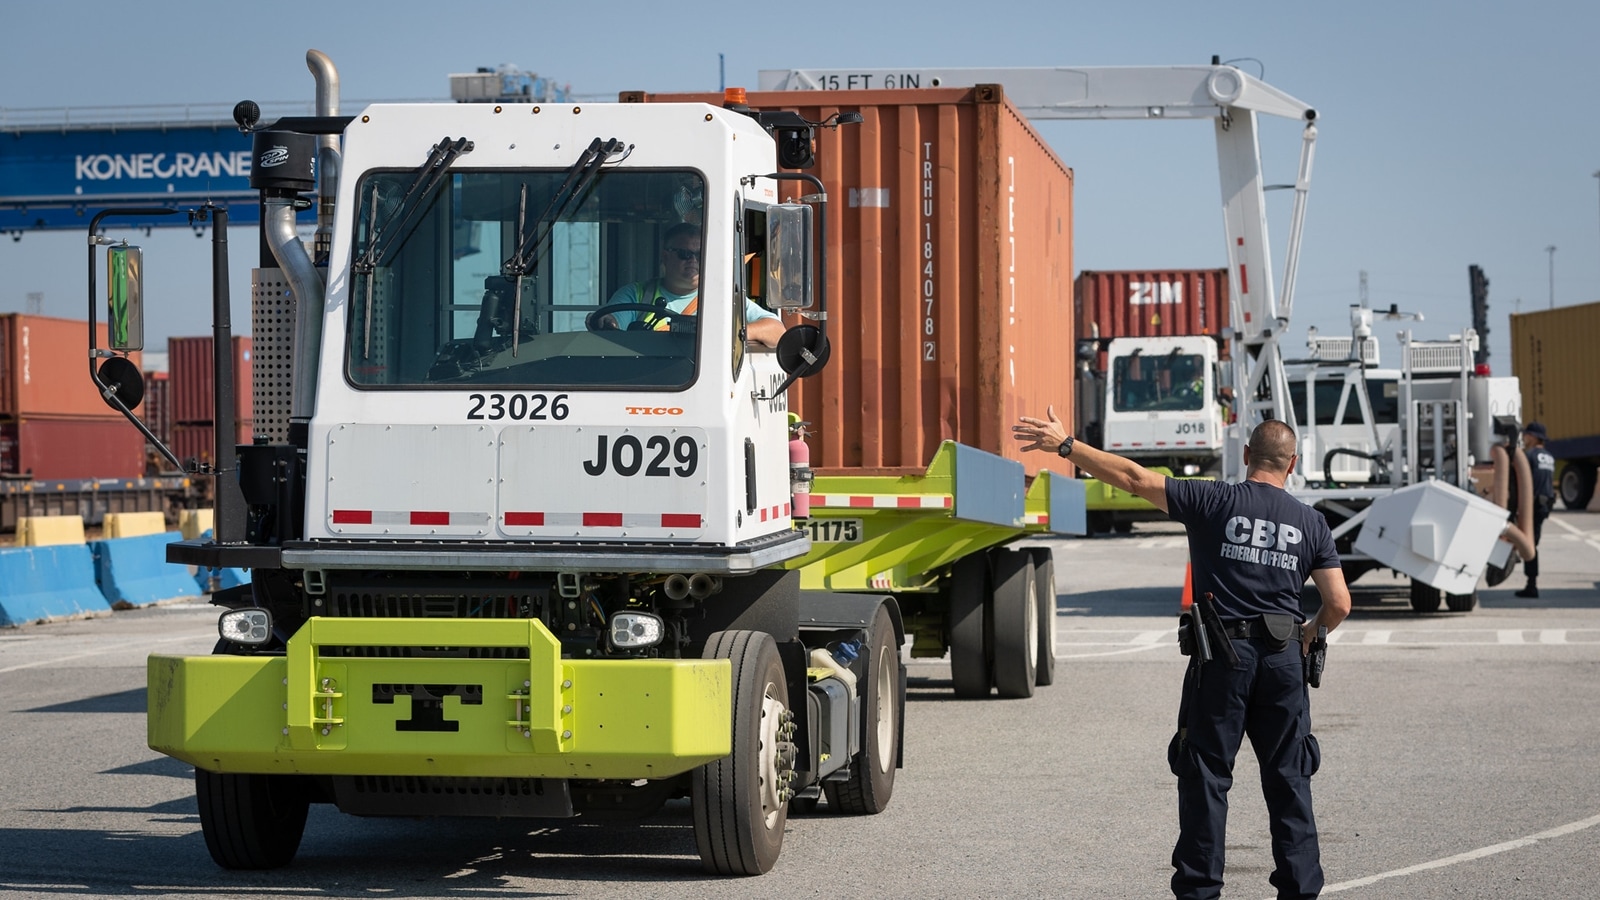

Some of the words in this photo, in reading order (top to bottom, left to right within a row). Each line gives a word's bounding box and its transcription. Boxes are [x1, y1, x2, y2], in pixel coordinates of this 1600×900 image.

[818, 75, 840, 91] 15
[847, 74, 873, 90] FT
[261, 152, 279, 161] TOP
[269, 154, 289, 163] SPIN
[923, 142, 933, 217] TRHU
[924, 222, 934, 336] 184078
[1129, 281, 1182, 304] ZIM
[466, 393, 570, 421] 23026
[625, 406, 684, 416] TICO
[1225, 515, 1303, 552] CBP
[1220, 542, 1260, 564] FEDERAL
[1260, 549, 1299, 572] OFFICER
